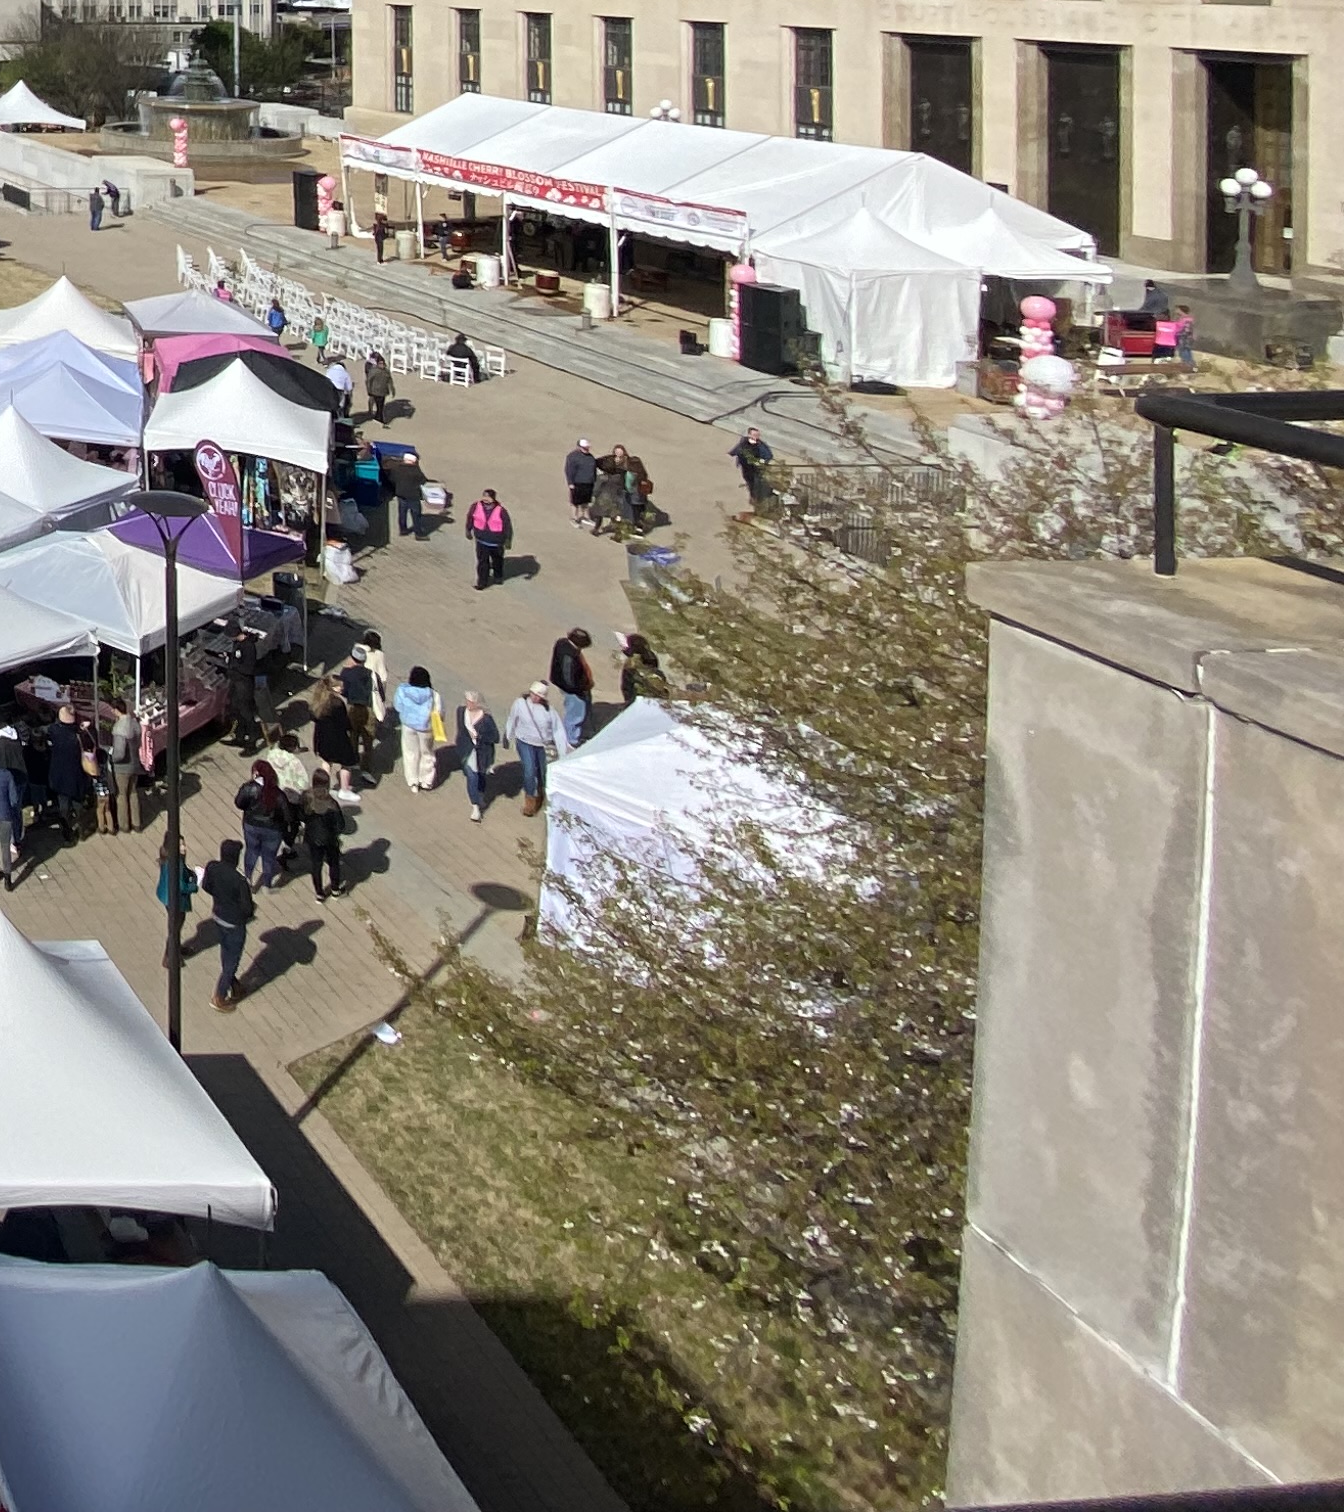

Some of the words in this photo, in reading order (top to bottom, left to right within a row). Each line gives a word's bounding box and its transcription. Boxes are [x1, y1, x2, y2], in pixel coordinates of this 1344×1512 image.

[505, 169, 553, 187] BLOSSOM
[208, 481, 237, 501] CLUCK
[214, 498, 239, 517] YEAH!
